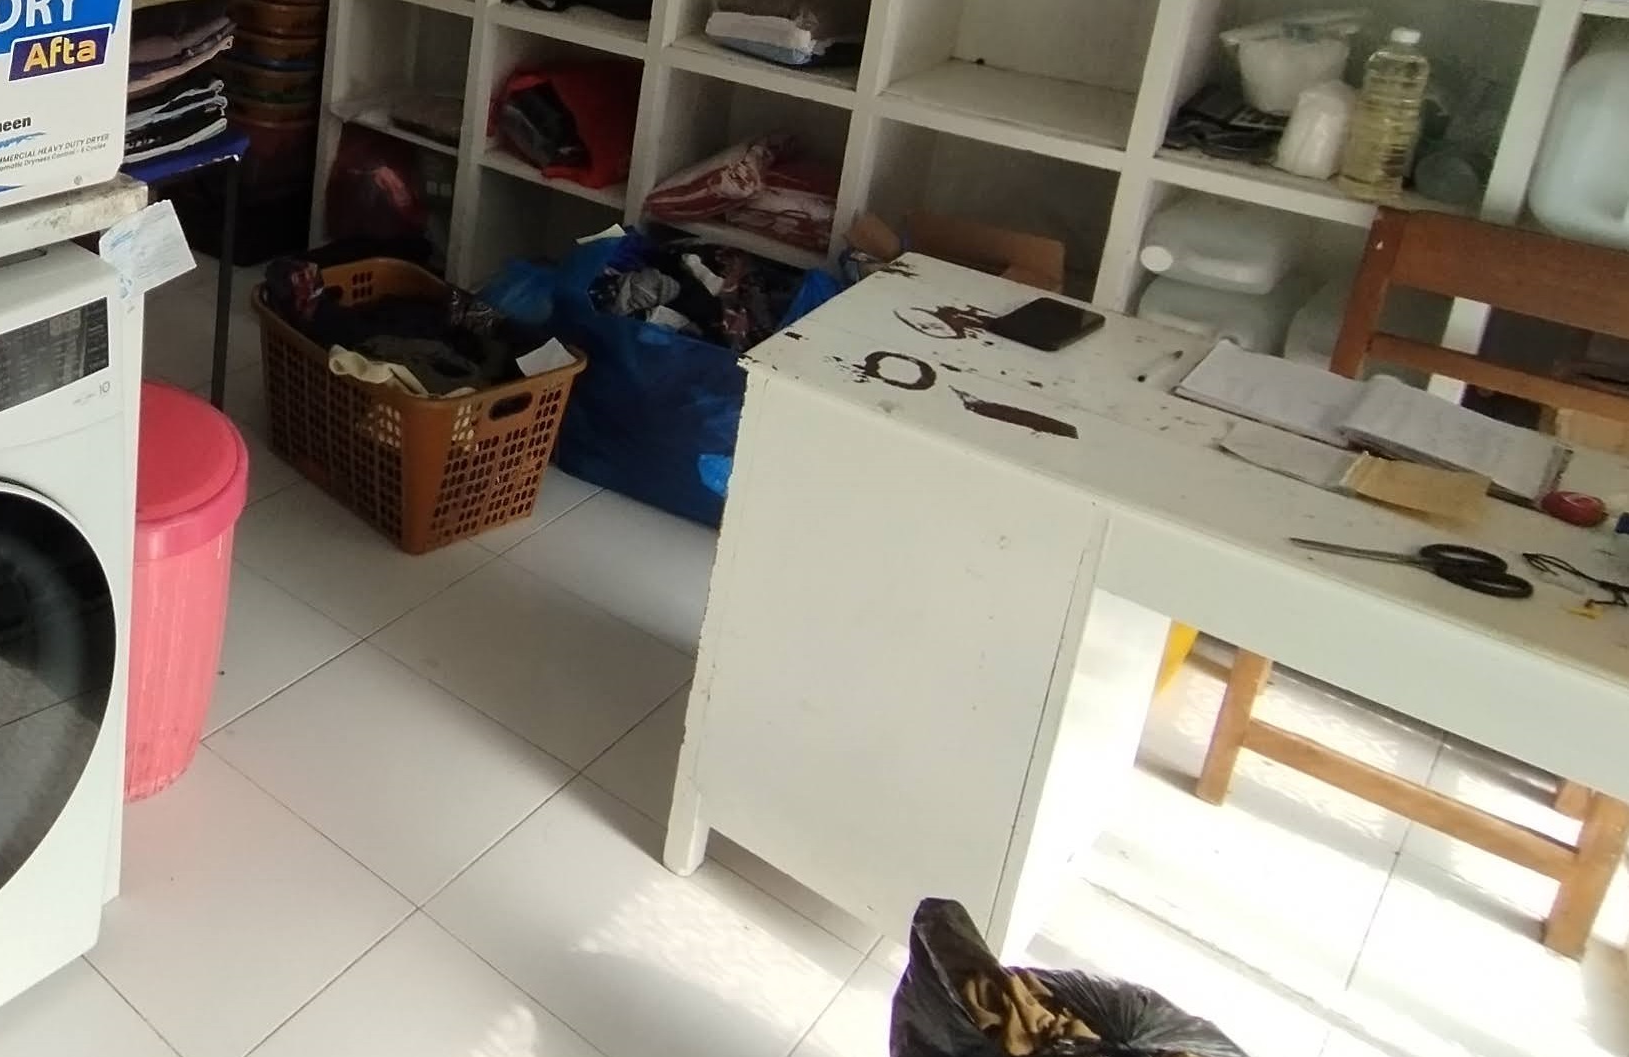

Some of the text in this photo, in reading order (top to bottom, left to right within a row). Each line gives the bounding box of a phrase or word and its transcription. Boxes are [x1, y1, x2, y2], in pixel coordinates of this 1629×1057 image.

[23, 36, 97, 72] Afta
[37, 141, 65, 156] HEAVY
[65, 138, 85, 150] DUTY
